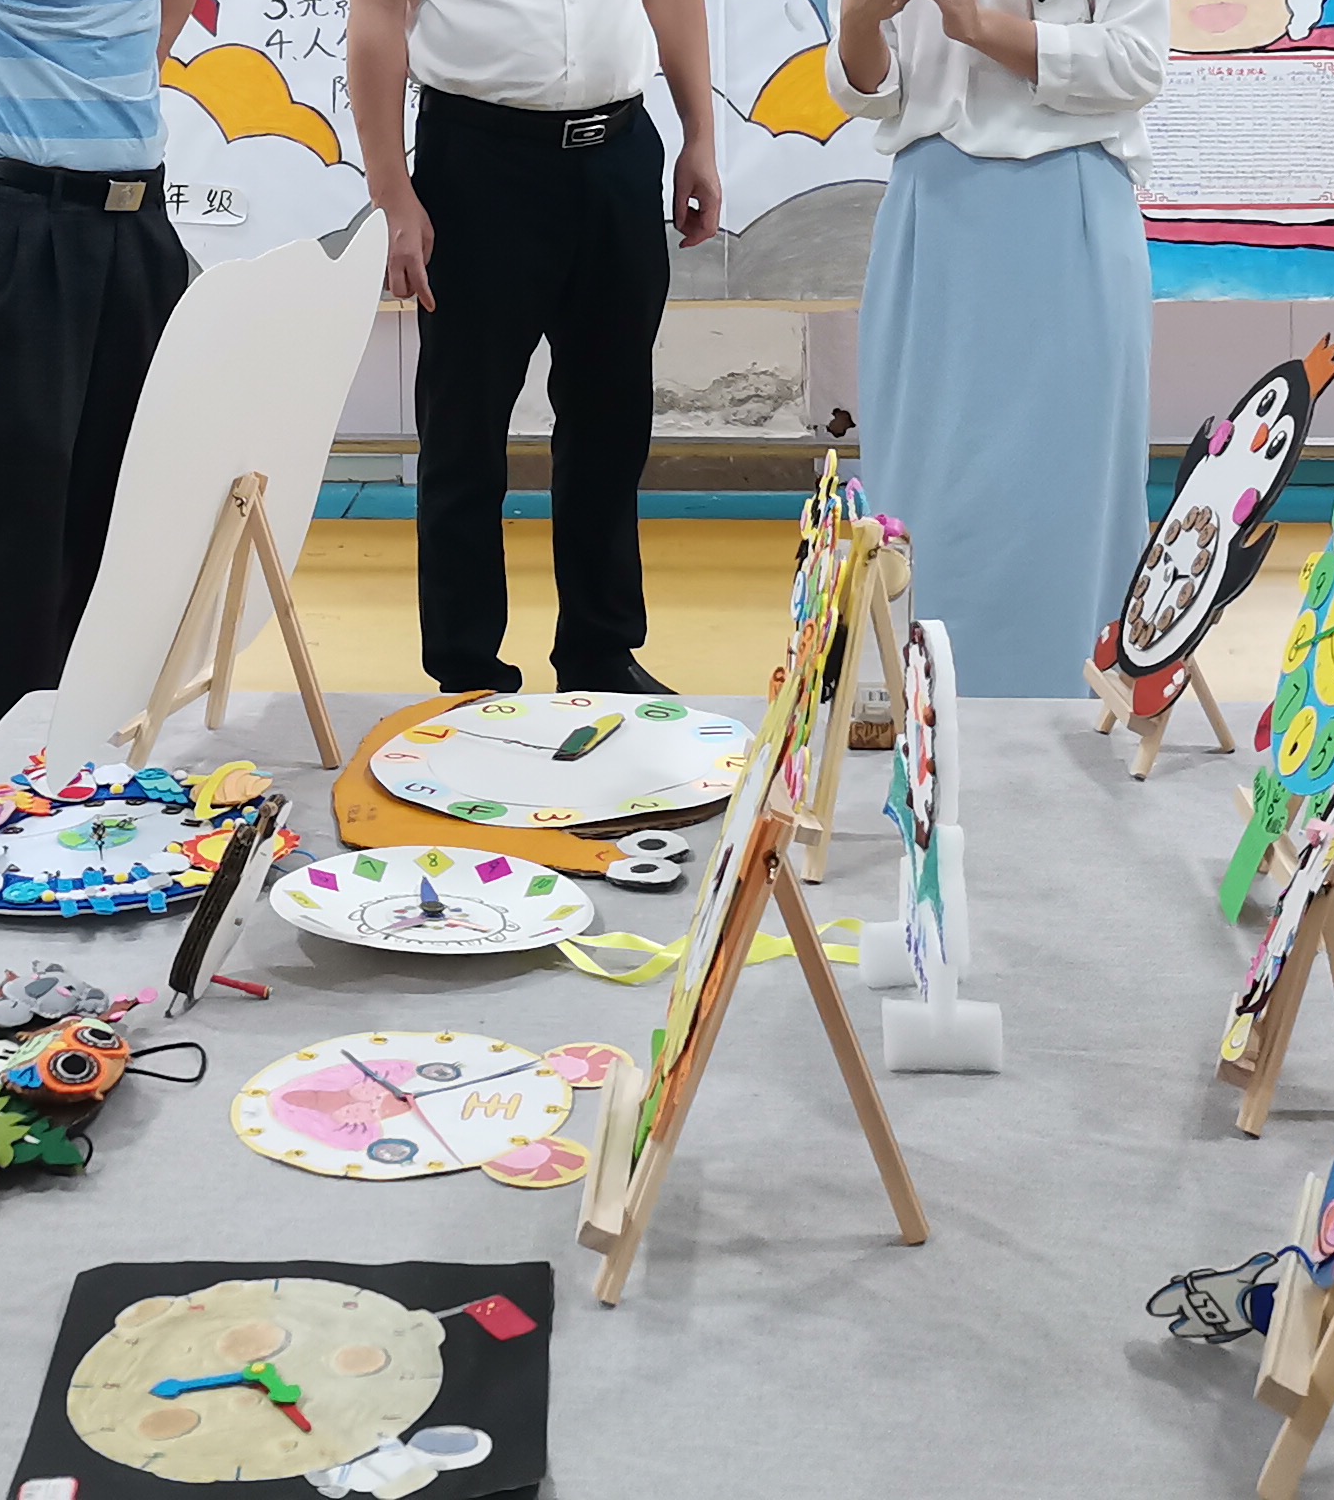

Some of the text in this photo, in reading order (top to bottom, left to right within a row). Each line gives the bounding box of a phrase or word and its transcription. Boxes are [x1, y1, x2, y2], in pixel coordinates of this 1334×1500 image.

[481, 702, 517, 716] 8
[549, 697, 592, 709] 9
[643, 703, 682, 720] 10
[412, 728, 451, 741] 7
[698, 723, 734, 736] 11
[404, 781, 436, 796] 5
[532, 811, 573, 824] 3
[426, 853, 439, 868] 8
